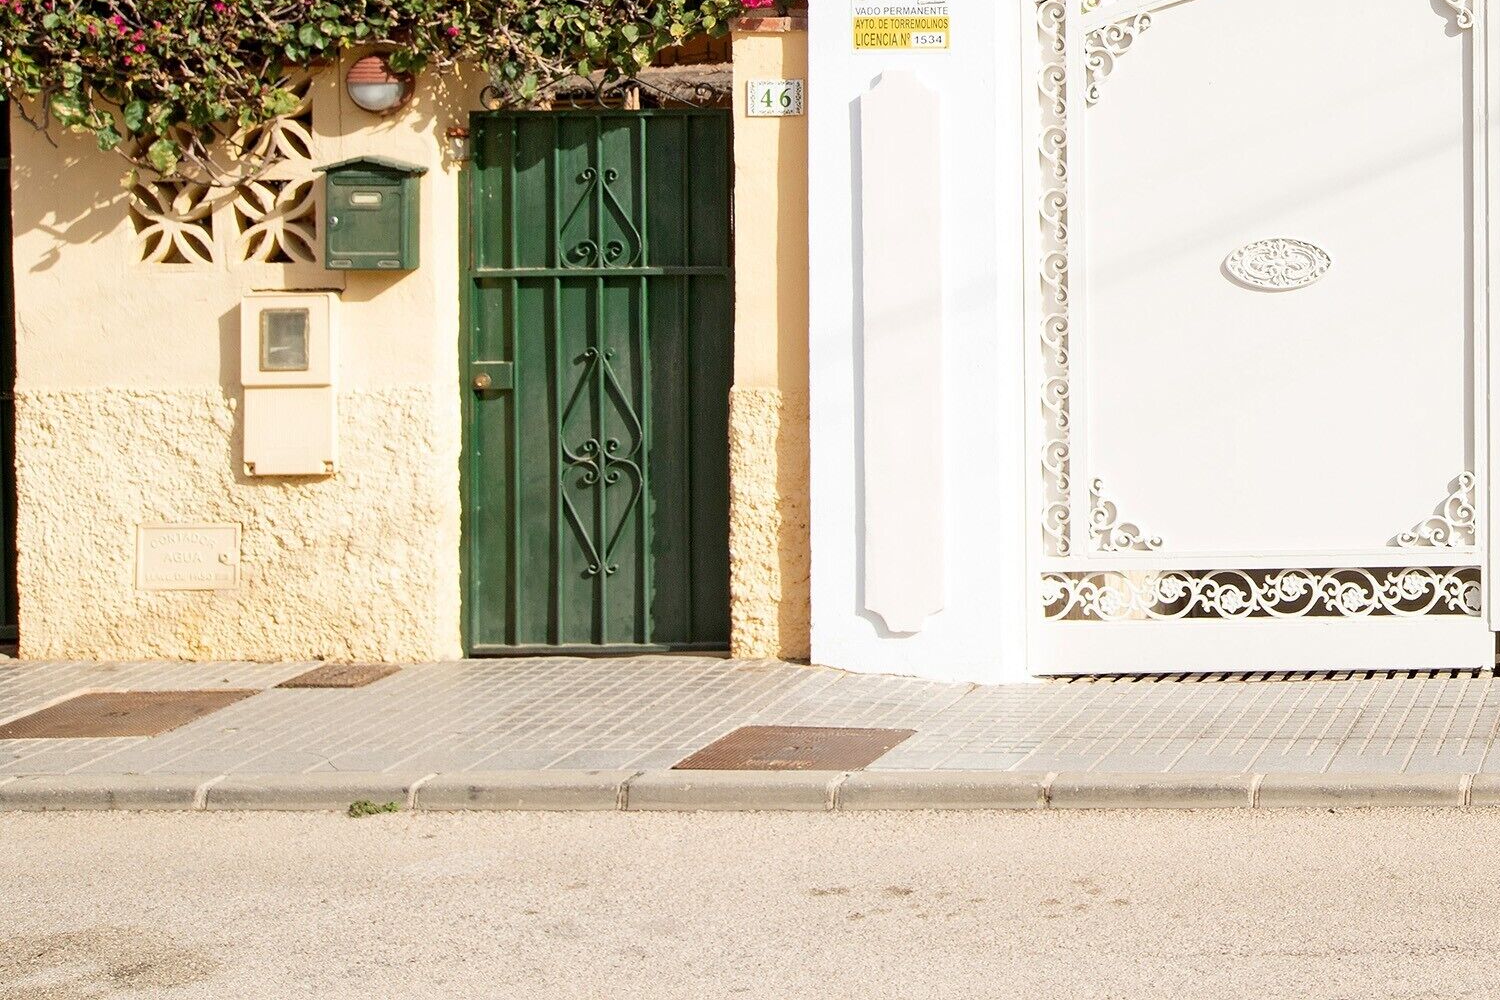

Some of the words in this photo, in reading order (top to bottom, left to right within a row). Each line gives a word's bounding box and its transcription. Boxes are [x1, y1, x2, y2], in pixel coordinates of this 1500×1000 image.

[855, 6, 881, 15] VADO
[883, 6, 949, 15] PERMANENTE
[855, 18, 877, 30] AYTO.
[878, 18, 889, 30] DE
[890, 18, 949, 30] TORREMOLINOS
[855, 33, 898, 47] LICENCIA
[913, 35, 942, 45] 1534
[760, 88, 792, 108] 46
[150, 531, 217, 550] CONTADOR
[163, 552, 202, 564] AGUA
